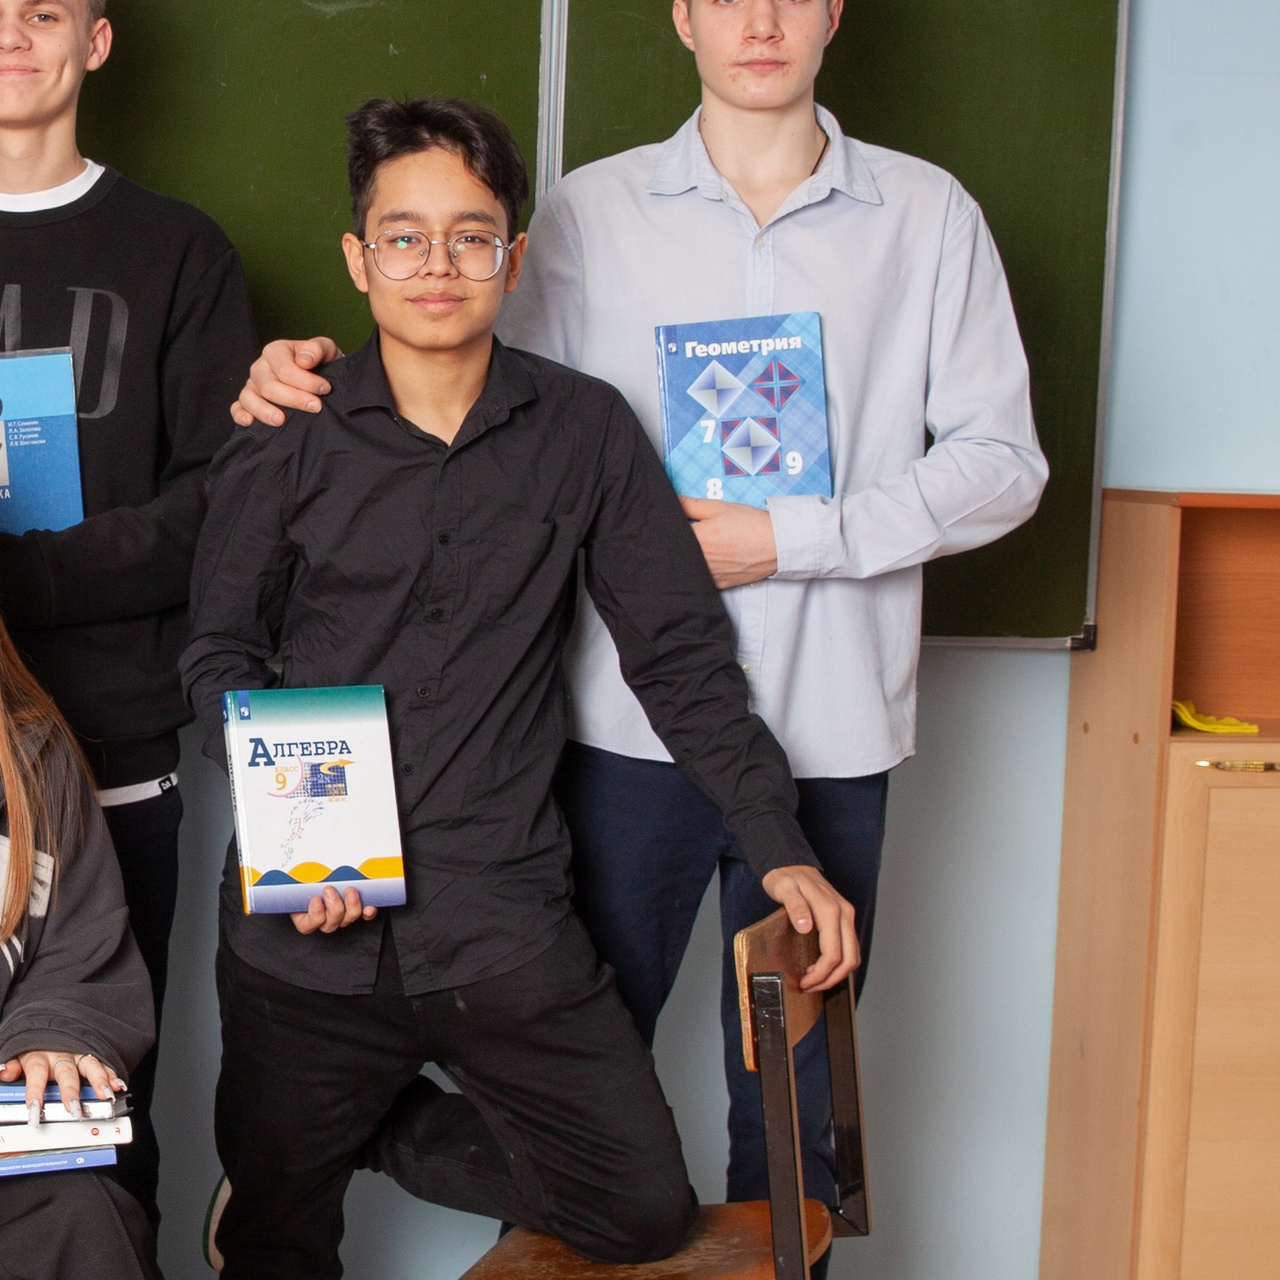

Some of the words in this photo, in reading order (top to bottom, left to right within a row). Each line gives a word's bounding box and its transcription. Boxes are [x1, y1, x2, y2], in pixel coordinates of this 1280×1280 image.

[685, 335, 802, 358] Геометрия
[700, 420, 716, 443] 7
[785, 451, 803, 475] 9
[706, 477, 724, 500] 8
[248, 737, 352, 767] АЛГЕБРА
[275, 772, 287, 791] 9
